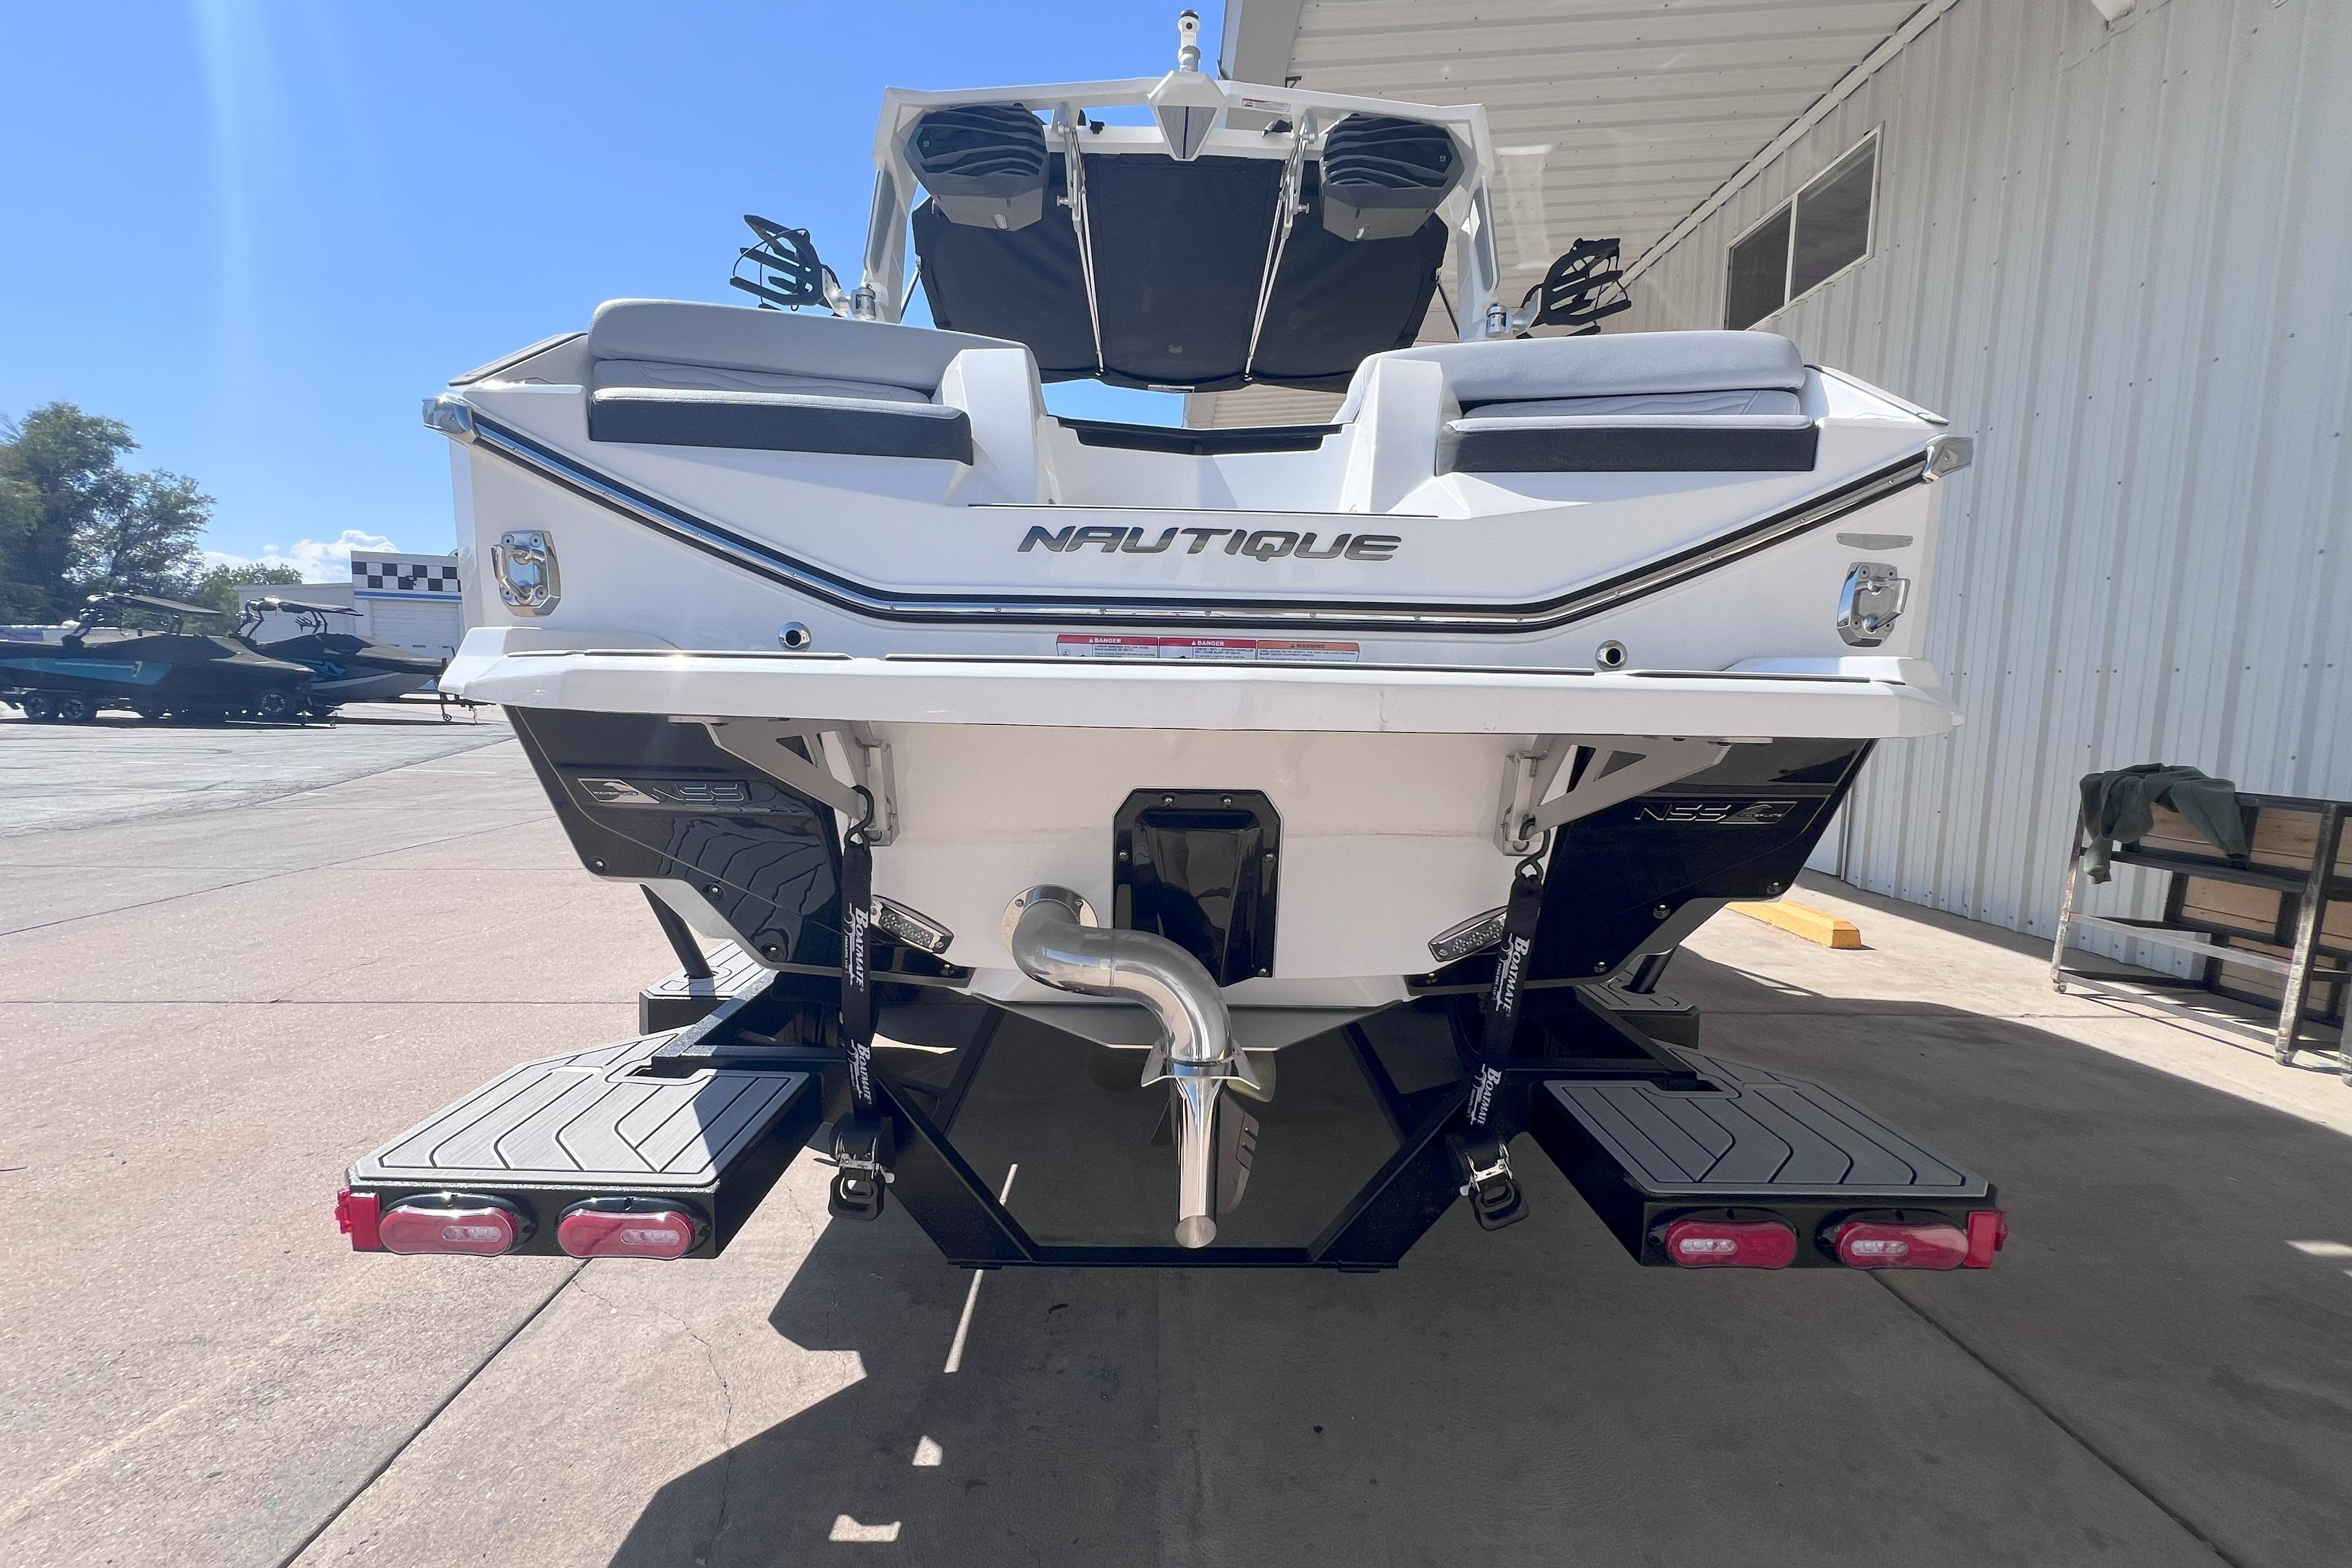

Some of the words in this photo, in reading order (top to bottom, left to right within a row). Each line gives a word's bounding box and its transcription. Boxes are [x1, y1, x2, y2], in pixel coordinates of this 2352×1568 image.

[1017, 525, 1402, 562] NAUTIQUE
[1633, 803, 1731, 821] NSS
[855, 908, 869, 988] BOATMATE
[1503, 936, 1530, 1013] BOATMATE
[1477, 1068, 1502, 1125] BOATMATE
